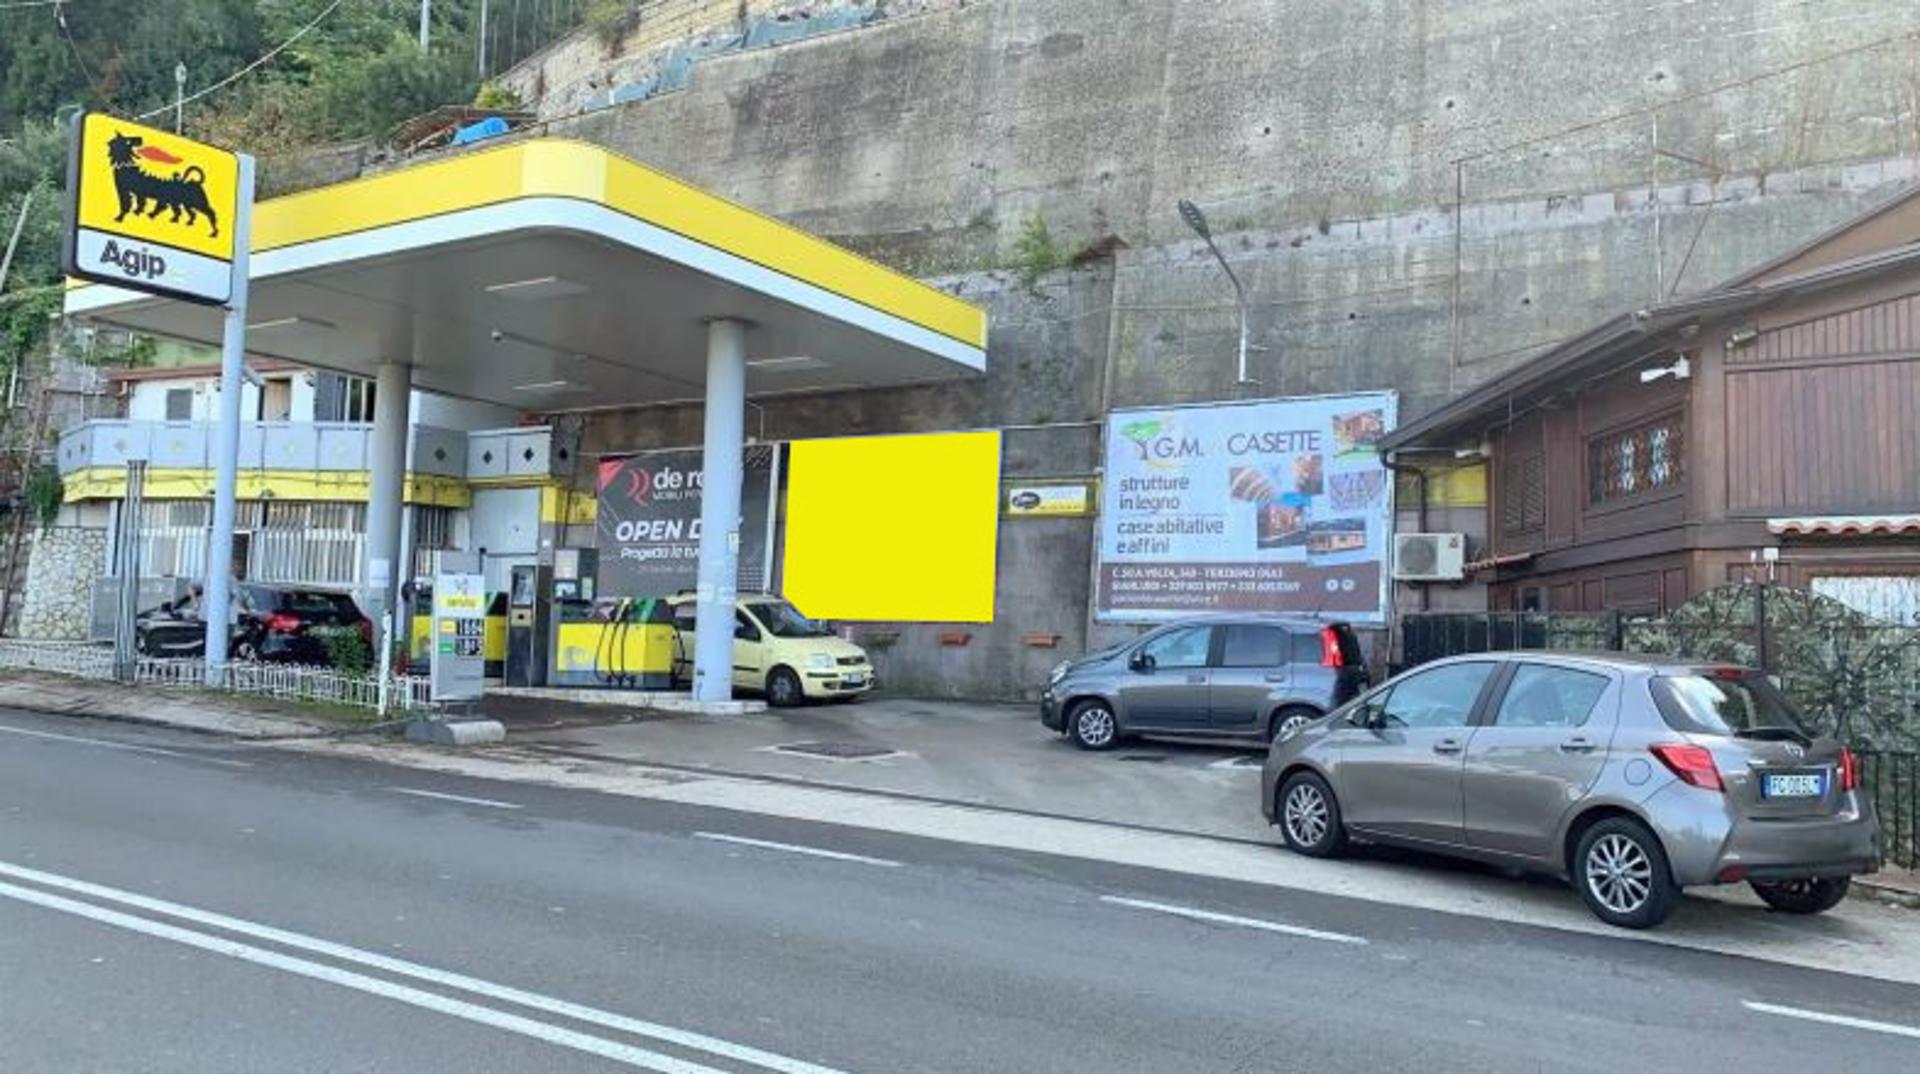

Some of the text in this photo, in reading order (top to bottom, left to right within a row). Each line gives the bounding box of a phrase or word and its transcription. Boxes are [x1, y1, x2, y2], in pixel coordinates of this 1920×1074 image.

[100, 240, 166, 279] Agip
[1227, 430, 1321, 455] CASETTE
[653, 467, 683, 490] de
[1119, 475, 1190, 492] strutture
[1119, 493, 1180, 514] in legno
[616, 519, 683, 542] OPEN
[1117, 521, 1154, 535] case
